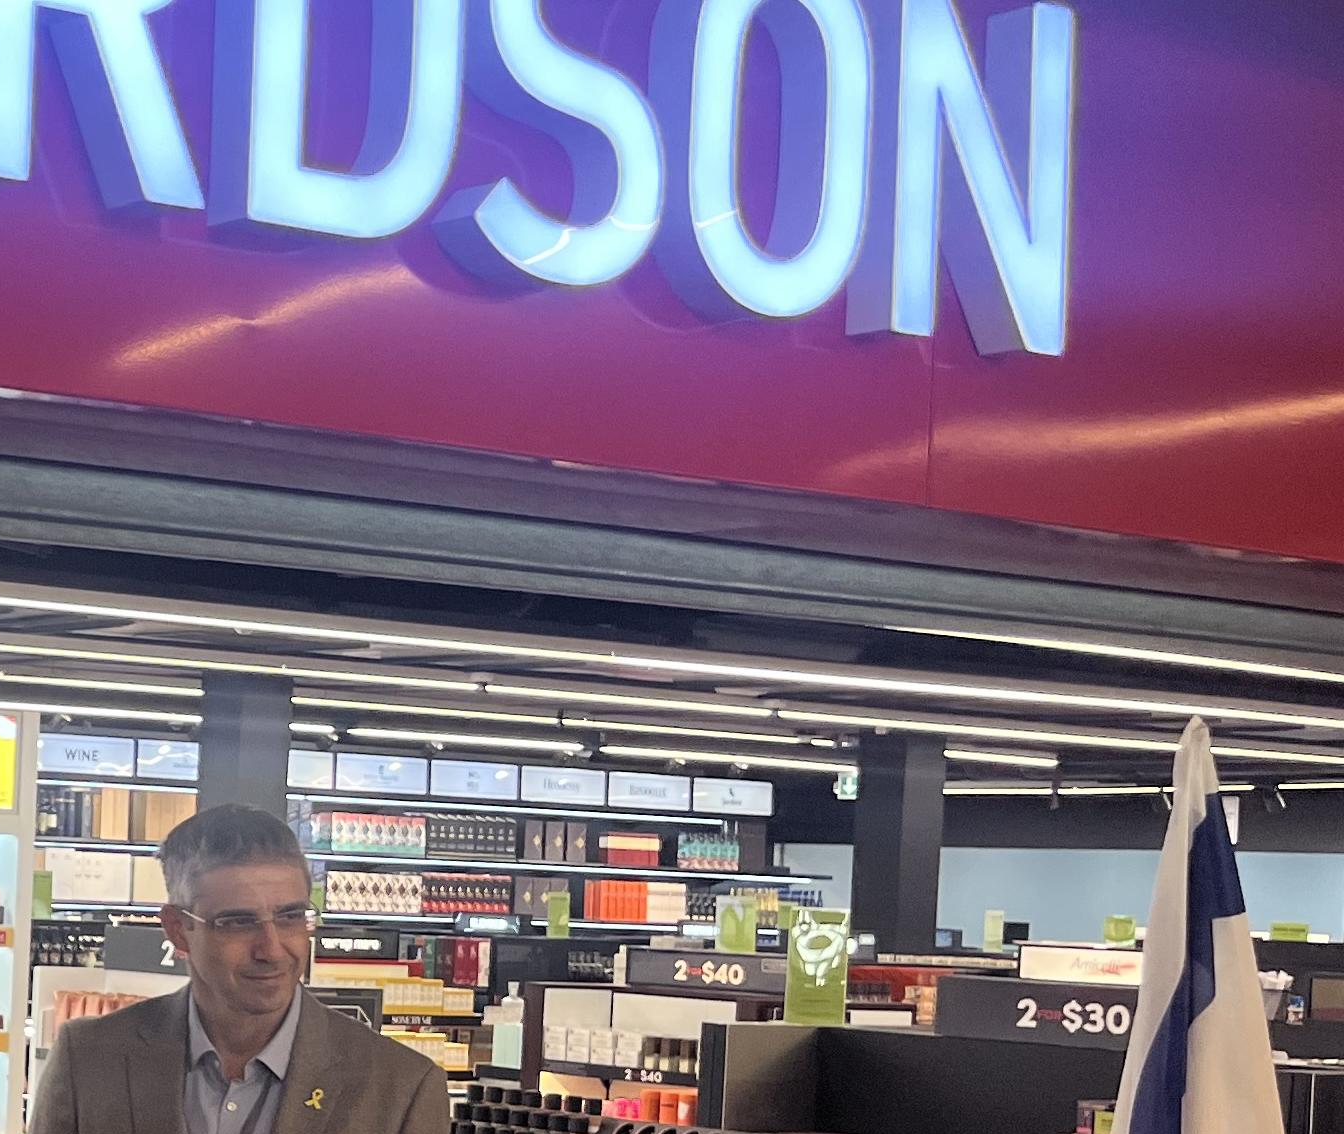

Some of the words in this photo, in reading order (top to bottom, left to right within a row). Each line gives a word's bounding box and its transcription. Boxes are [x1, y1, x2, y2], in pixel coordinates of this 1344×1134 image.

[64, 747, 99, 762] WINE
[160, 939, 176, 967] 2
[672, 959, 688, 981] 2
[700, 959, 745, 986] $40
[1015, 997, 1038, 1029] 2
[1061, 999, 1131, 1035] $30
[624, 1069, 633, 1082] 2
[639, 1069, 663, 1085] $40
